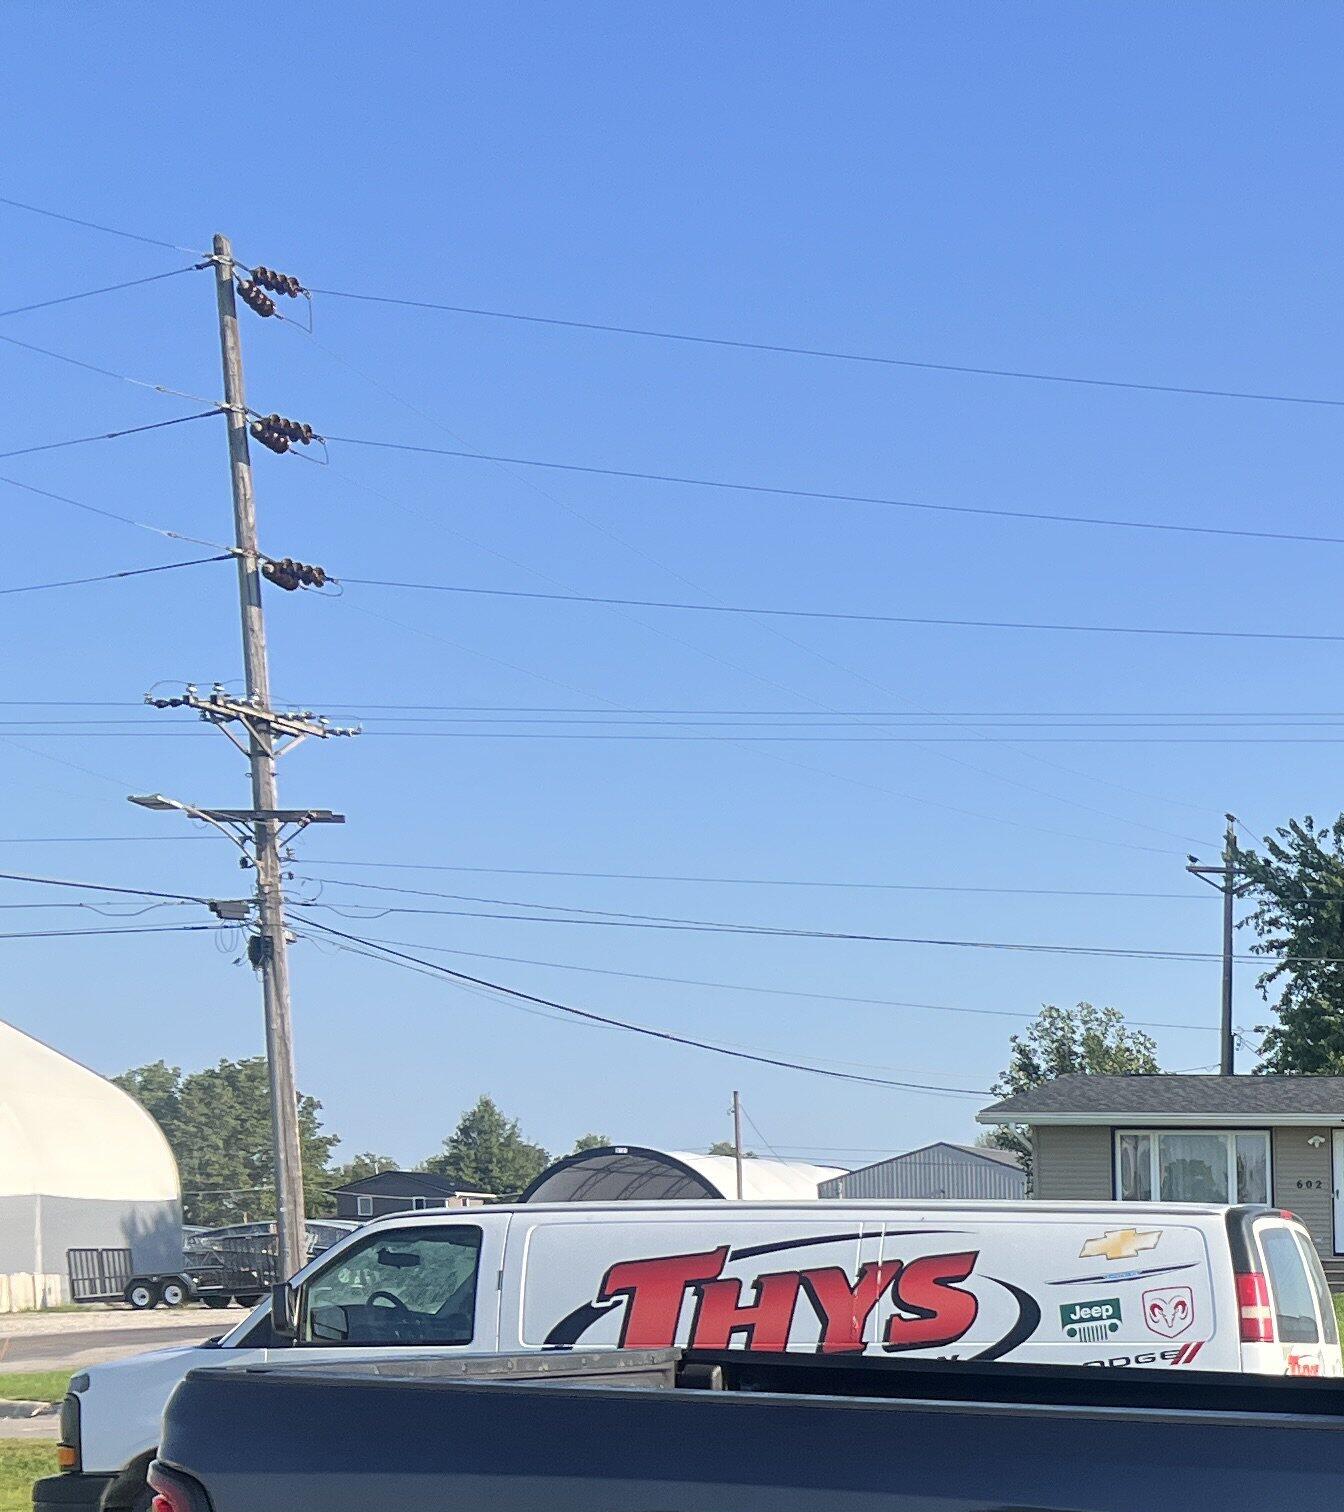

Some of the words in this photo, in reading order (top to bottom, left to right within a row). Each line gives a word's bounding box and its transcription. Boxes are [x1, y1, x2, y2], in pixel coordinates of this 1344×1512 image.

[1296, 1179, 1323, 1189] 602
[597, 1245, 980, 1355] THYS
[1070, 1304, 1113, 1320] Jeep
